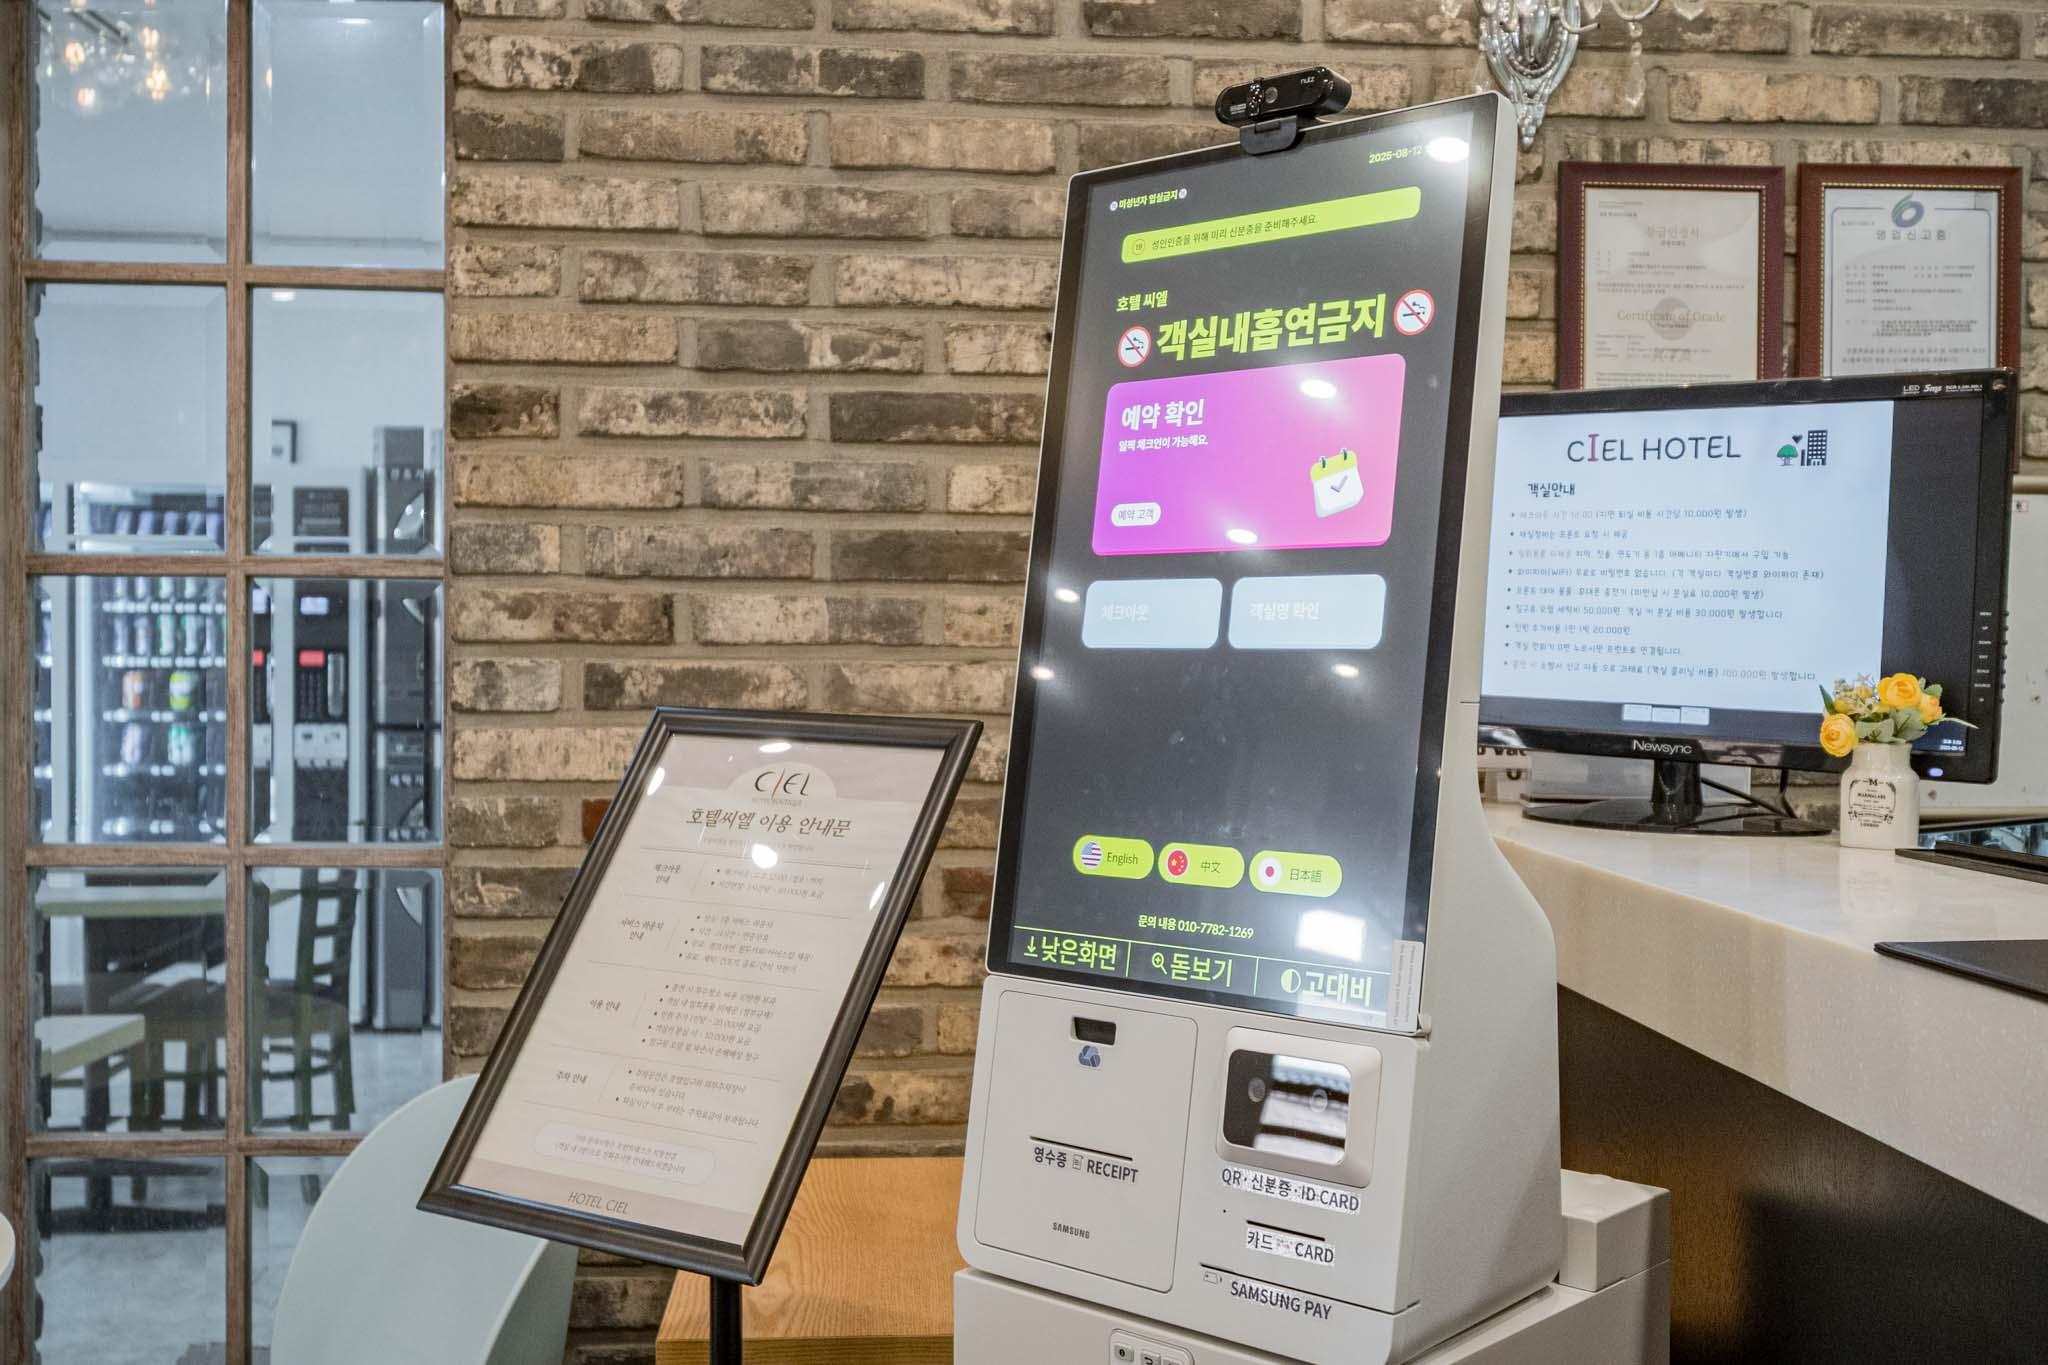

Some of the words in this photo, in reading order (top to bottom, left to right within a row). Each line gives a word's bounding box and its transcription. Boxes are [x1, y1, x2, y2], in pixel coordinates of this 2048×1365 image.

[1118, 192, 1148, 209] 미성년자
[1149, 188, 1178, 206] 입실금지
[1151, 231, 1192, 251] 성인인증을
[1193, 228, 1210, 244] 위해
[1210, 226, 1228, 242] 미리
[1229, 221, 1262, 240] 신분증을
[1116, 294, 1141, 312] 호텔
[1142, 290, 1168, 310] 씨엘
[1157, 293, 1387, 362] 객실내흡연금지
[1121, 402, 1160, 430] 예약
[1164, 398, 1205, 428] 확인
[1567, 433, 1634, 462] CIEL
[1642, 435, 1742, 461] HOTEL
[1528, 482, 1576, 498] 객실안내
[1117, 508, 1136, 522] 예약
[1137, 506, 1154, 521] 고객
[1633, 738, 1692, 755] Newsync
[754, 768, 810, 800] CIEL
[1868, 778, 1878, 786] M
[686, 808, 755, 830] 호텔씨엘
[760, 814, 793, 834] 이용
[799, 816, 852, 839] 안내문
[1106, 851, 1139, 866] English
[1200, 861, 1222, 874] 中文
[1290, 868, 1322, 884] 日本語
[1138, 915, 1156, 930] 문의
[1158, 916, 1177, 932] 내용
[1178, 919, 1254, 940] 010-7782-1269
[1040, 936, 1117, 972] 낮은화면
[1170, 952, 1233, 988] 돋보기
[1304, 971, 1373, 1008] 고대비
[1034, 1145, 1068, 1168] 영수증
[1086, 1158, 1139, 1184] RECEIPT
[568, 1191, 602, 1210] HOTEL
[606, 1199, 629, 1215] CIEL
[1319, 1188, 1360, 1213] CARD
[1052, 1221, 1091, 1240] SAMSUNG
[1248, 1229, 1273, 1251] 카드
[1294, 1242, 1335, 1264] CARD
[1230, 1280, 1301, 1313] SAMSUNG
[1304, 1298, 1332, 1320] PAY
